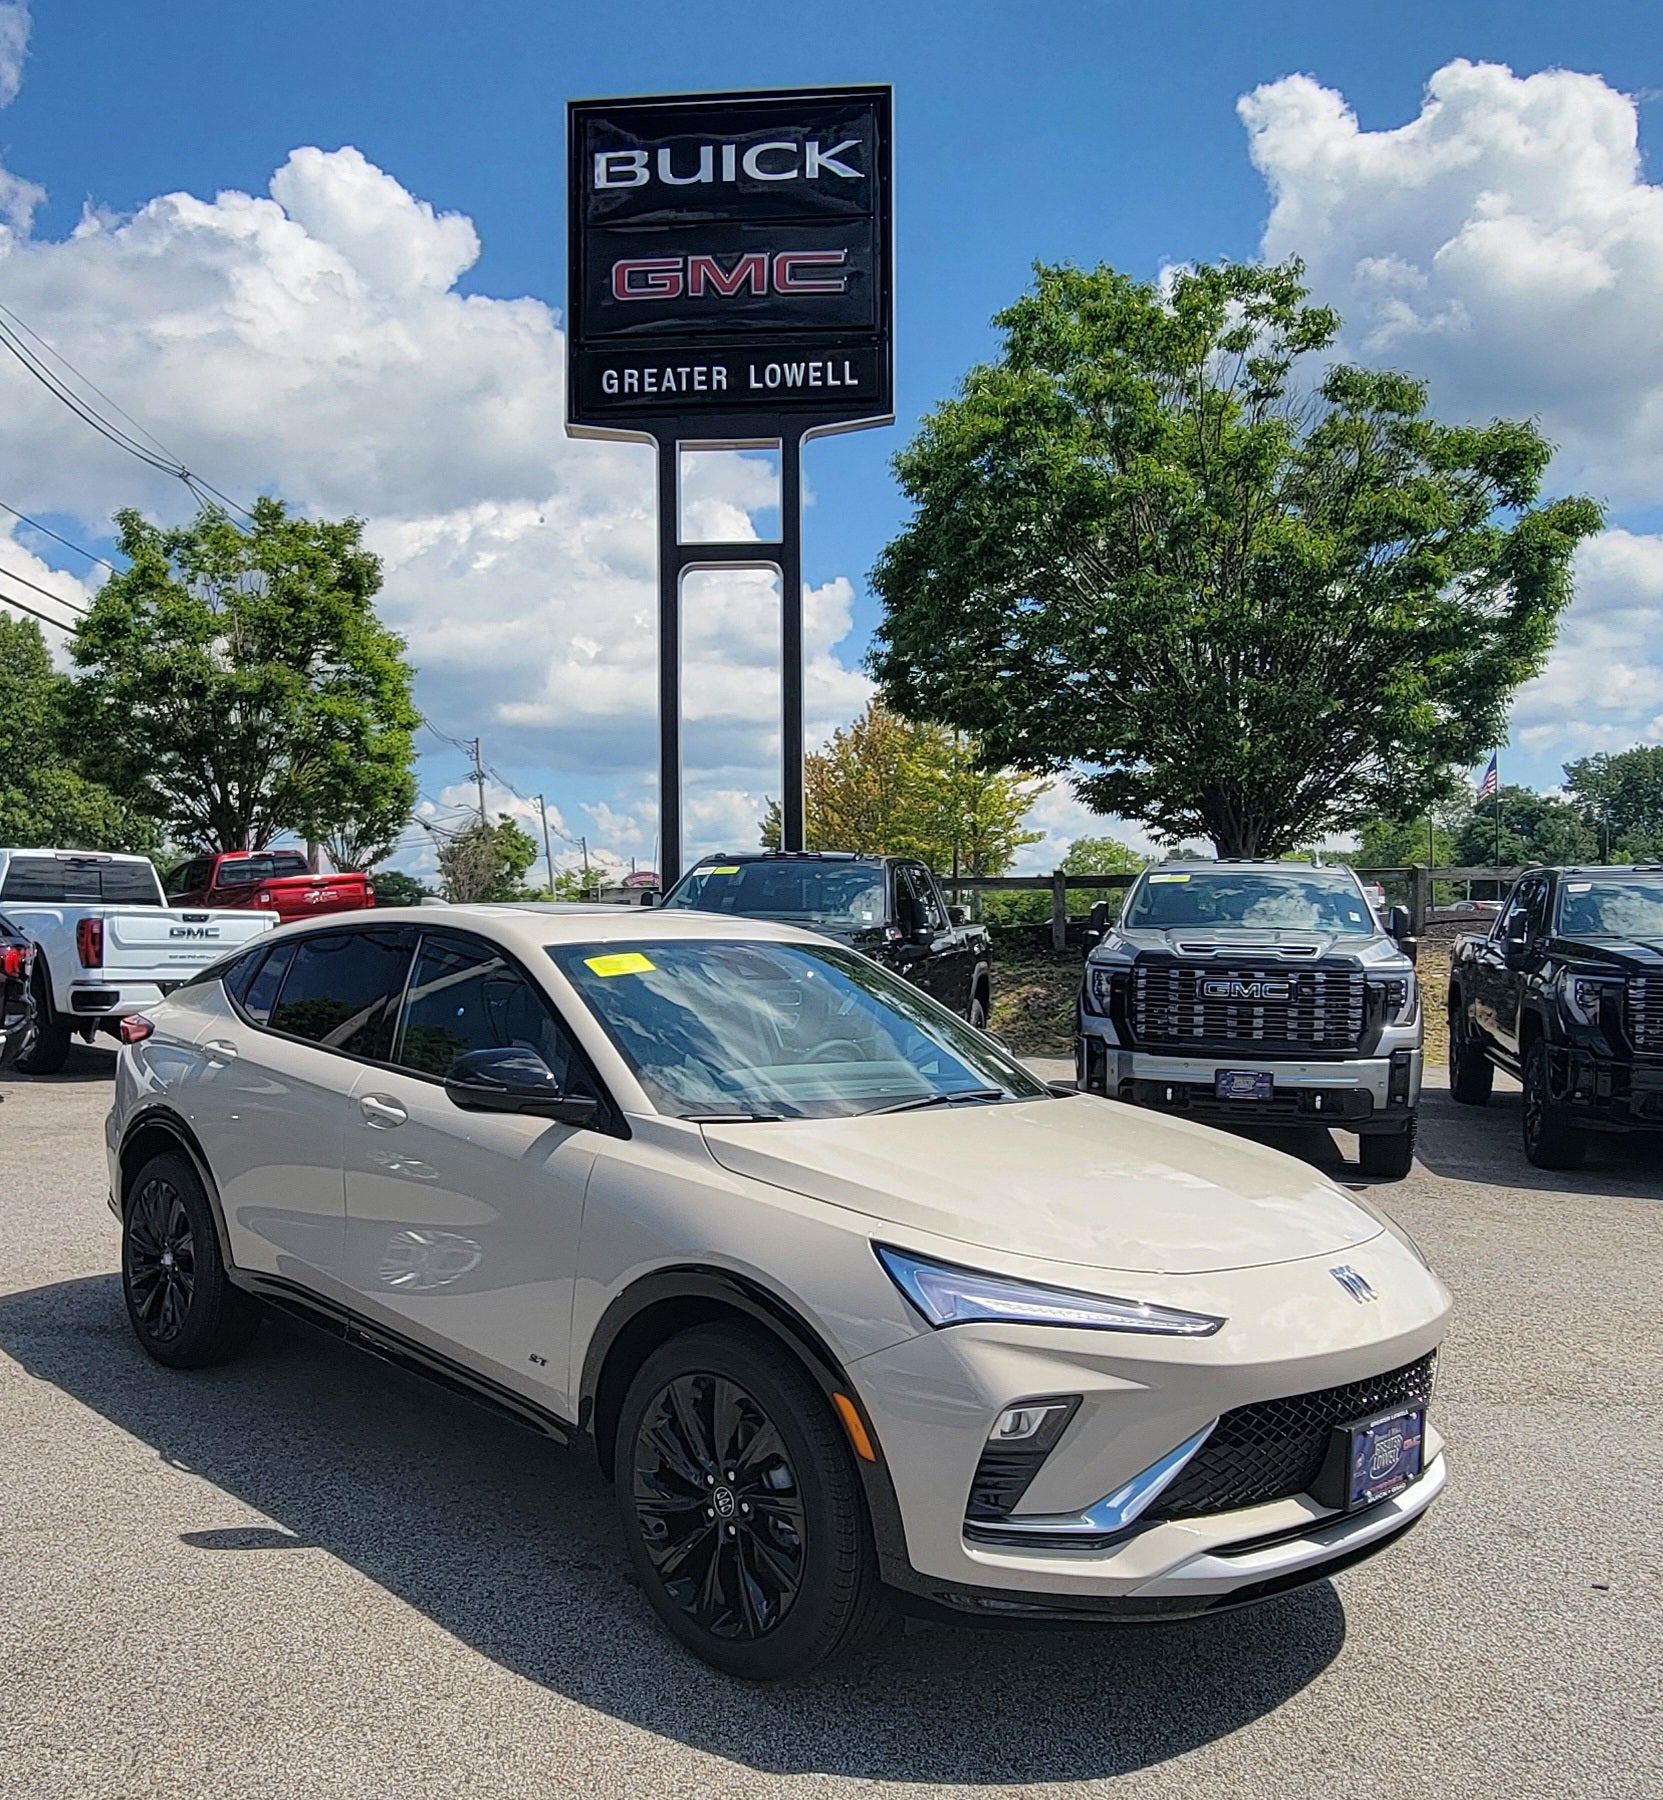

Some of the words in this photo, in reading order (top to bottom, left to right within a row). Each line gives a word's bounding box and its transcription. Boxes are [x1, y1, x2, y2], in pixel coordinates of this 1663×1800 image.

[594, 139, 865, 189] BUICK
[612, 250, 847, 301] GMC
[602, 366, 728, 394] GREATER
[749, 360, 859, 389] LOWELL
[169, 927, 220, 939] GMC
[1204, 981, 1289, 999] GMC
